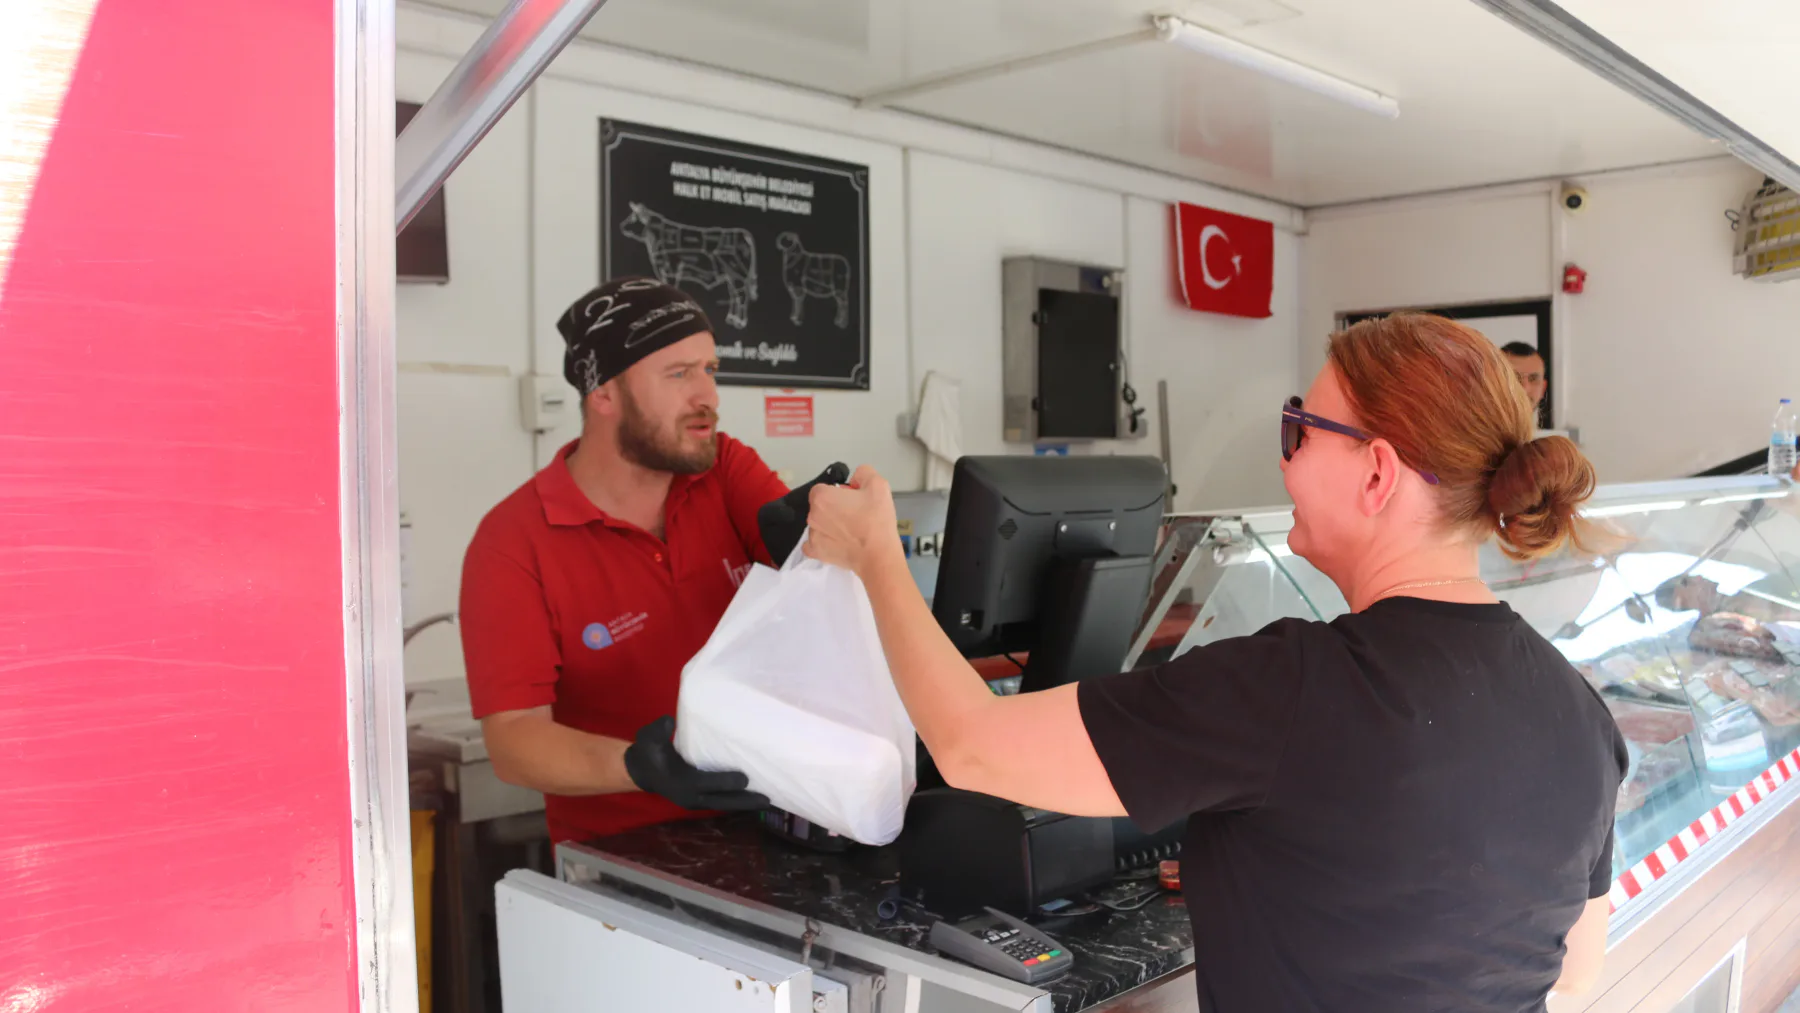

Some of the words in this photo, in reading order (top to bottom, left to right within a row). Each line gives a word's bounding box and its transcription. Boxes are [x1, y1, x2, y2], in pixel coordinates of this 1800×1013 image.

[673, 181, 699, 198] HALK
[700, 184, 711, 200] ET
[744, 347, 757, 360] ve
